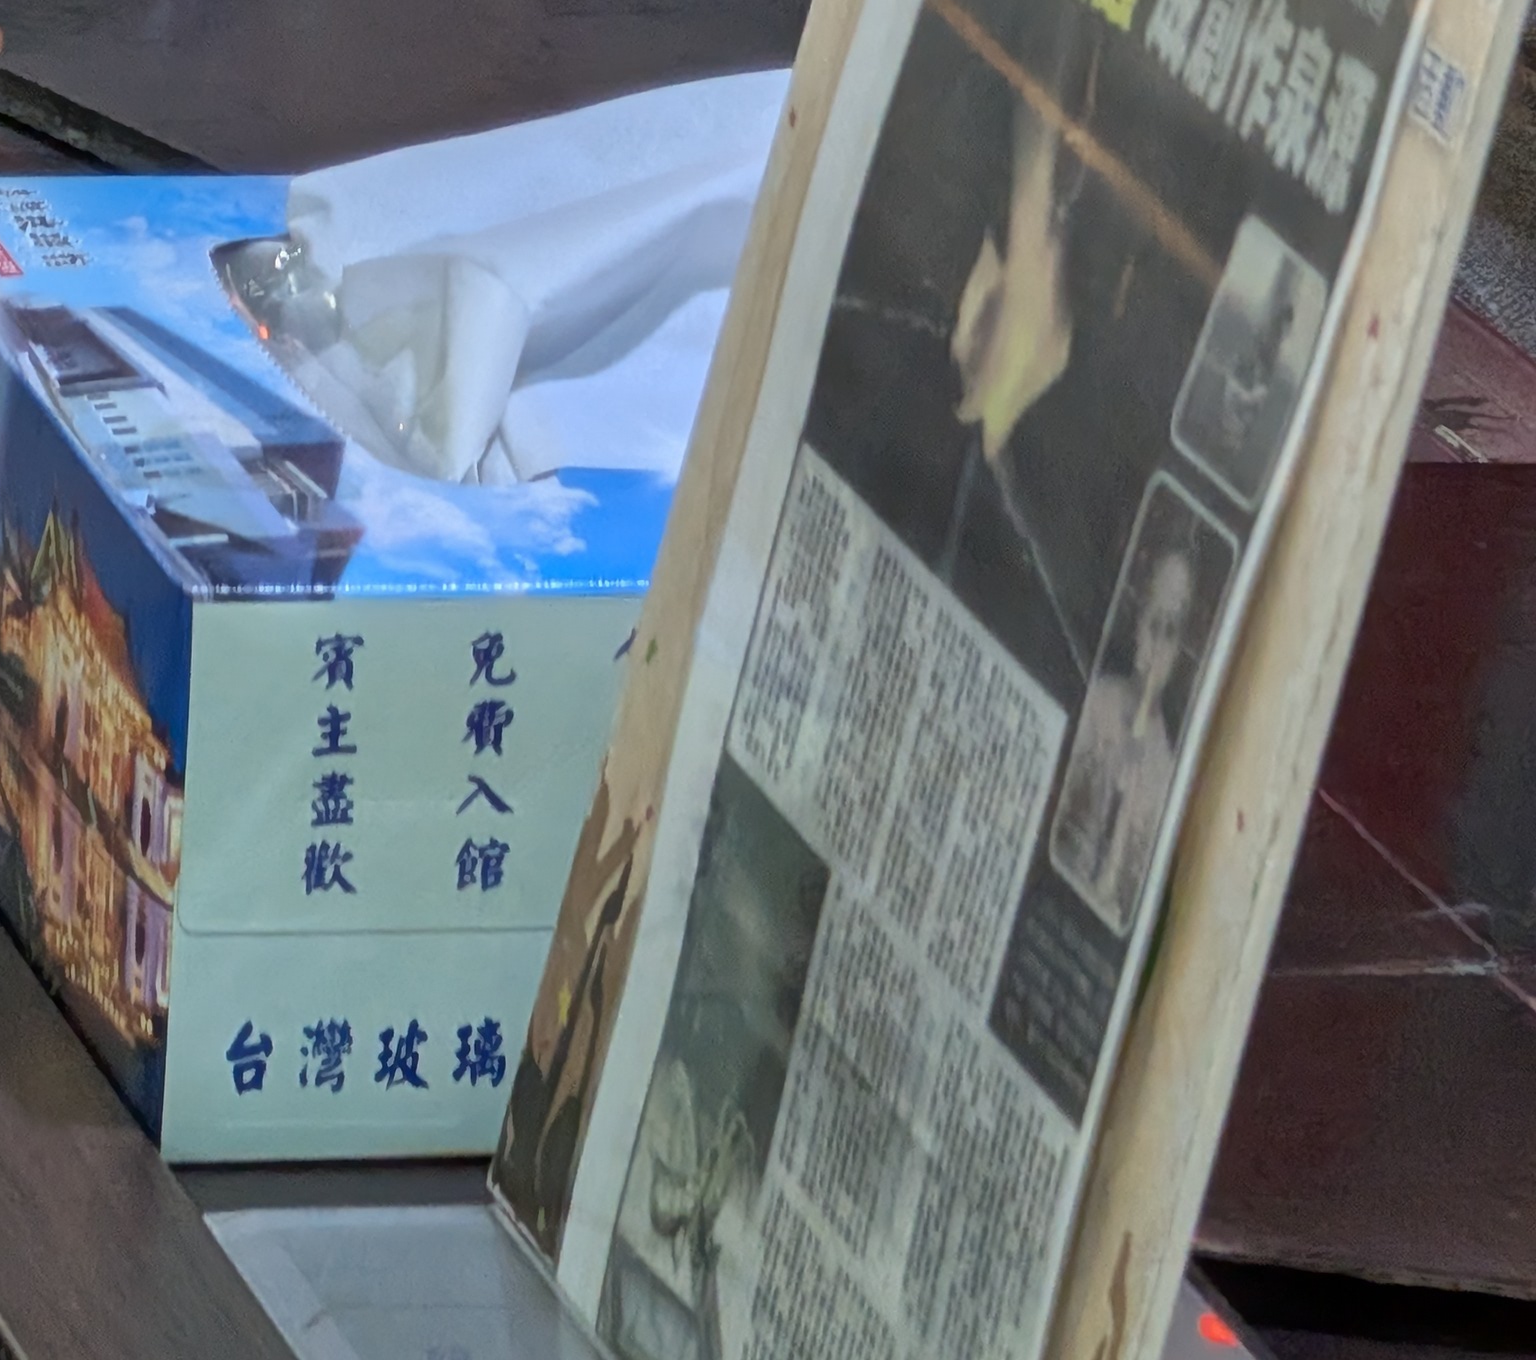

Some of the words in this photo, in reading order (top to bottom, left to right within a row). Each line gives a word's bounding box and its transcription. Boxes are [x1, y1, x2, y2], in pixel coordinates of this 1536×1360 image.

[300, 632, 364, 896] 賓主盡歡
[455, 630, 517, 892] 免費入館
[225, 1017, 507, 1096] 台灣玻璃
